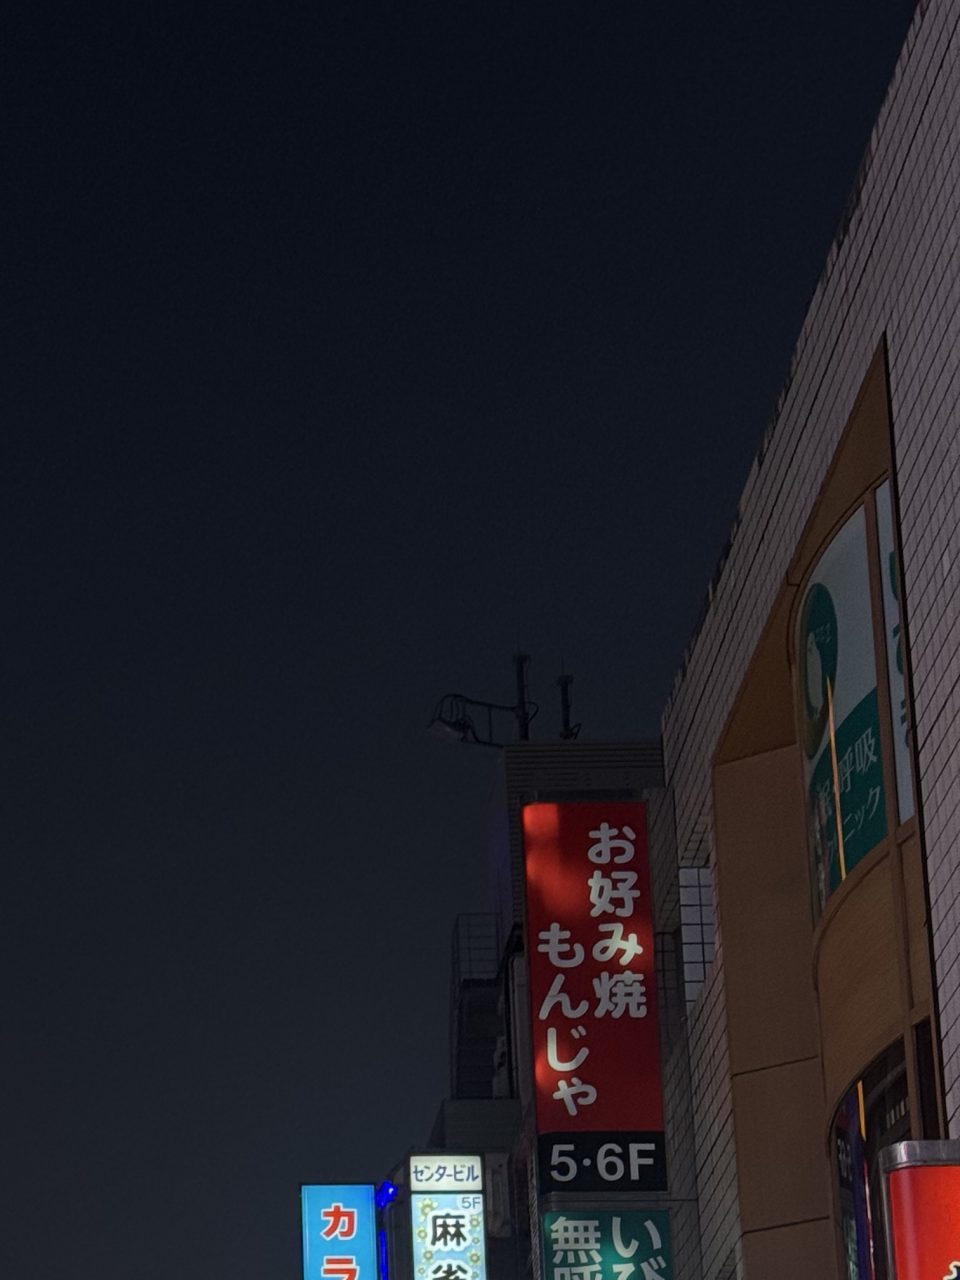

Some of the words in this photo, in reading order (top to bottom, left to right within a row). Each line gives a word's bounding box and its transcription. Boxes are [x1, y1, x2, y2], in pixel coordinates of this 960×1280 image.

[587, 822, 647, 1018] お好み焼
[412, 1166, 480, 1183] センタービル
[461, 1197, 481, 1209] 5F
